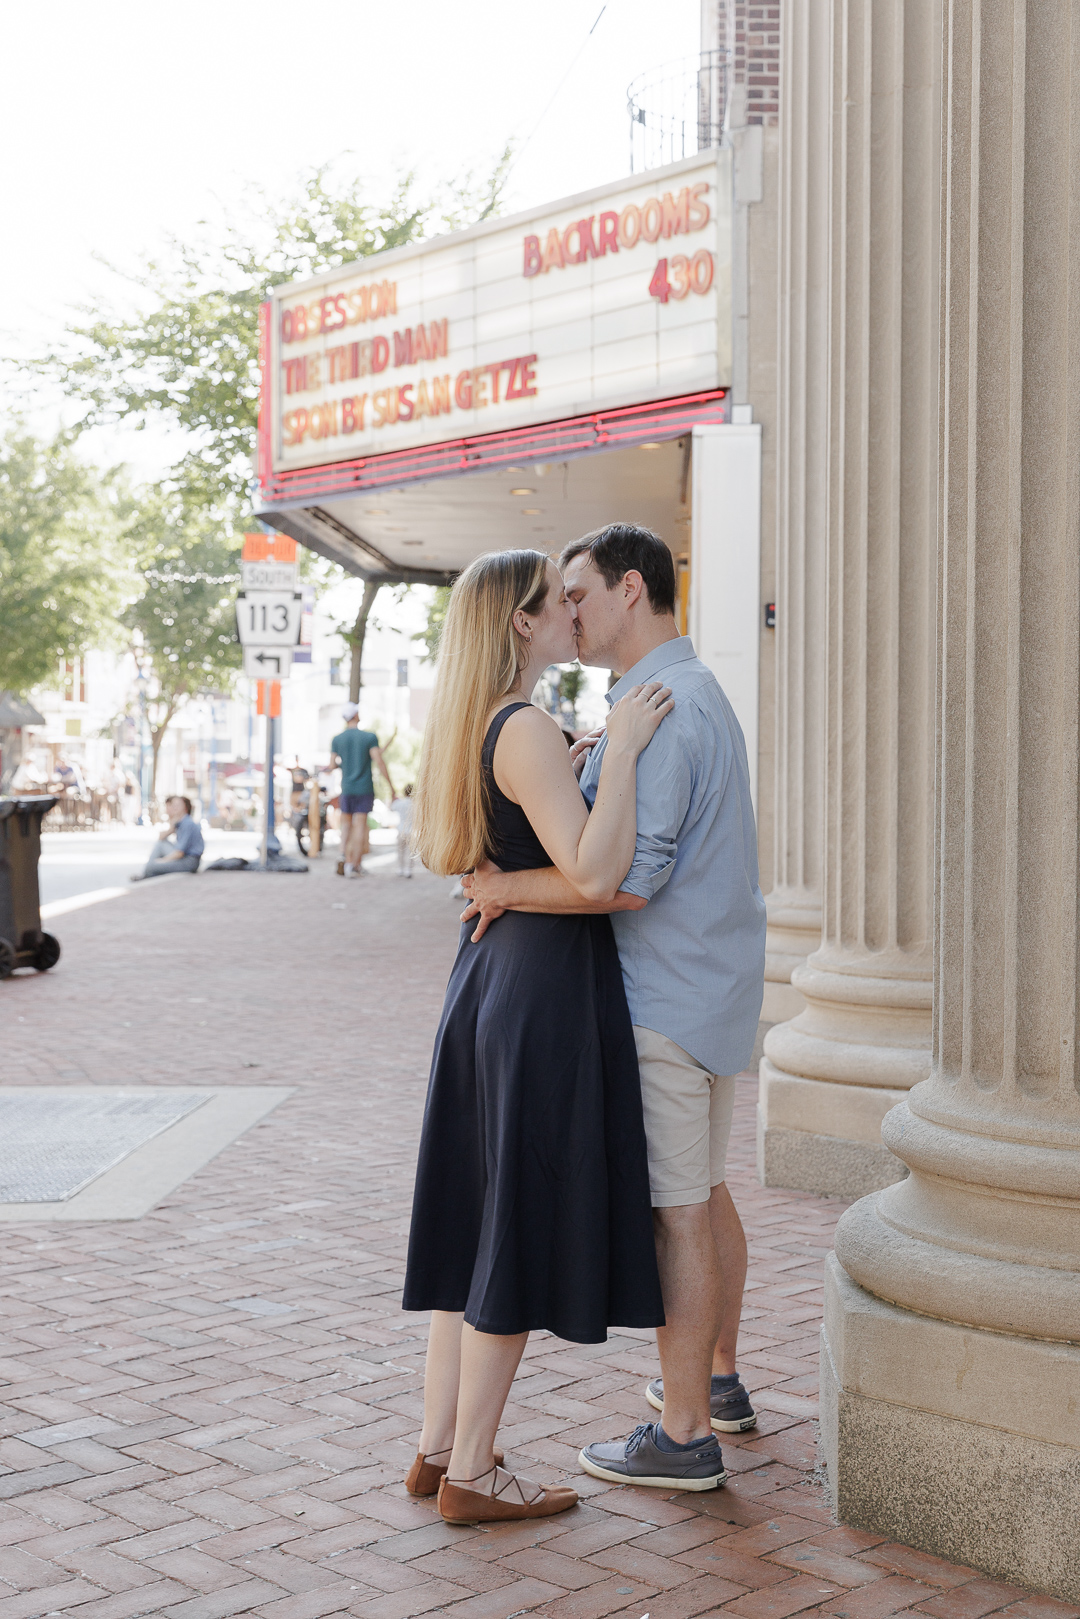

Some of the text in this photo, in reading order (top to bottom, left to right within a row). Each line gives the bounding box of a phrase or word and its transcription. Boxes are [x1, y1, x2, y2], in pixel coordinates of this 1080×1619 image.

[523, 182, 710, 278] BACKROOMS
[648, 248, 714, 304] 430
[281, 279, 397, 344] OBSESSION
[281, 317, 448, 395] THE THIRD MAN
[341, 392, 368, 435] BY
[371, 374, 450, 429] SUSAN
[454, 353, 538, 410] GETZE
[248, 567, 292, 584] SOUTH
[250, 604, 289, 633] 113
